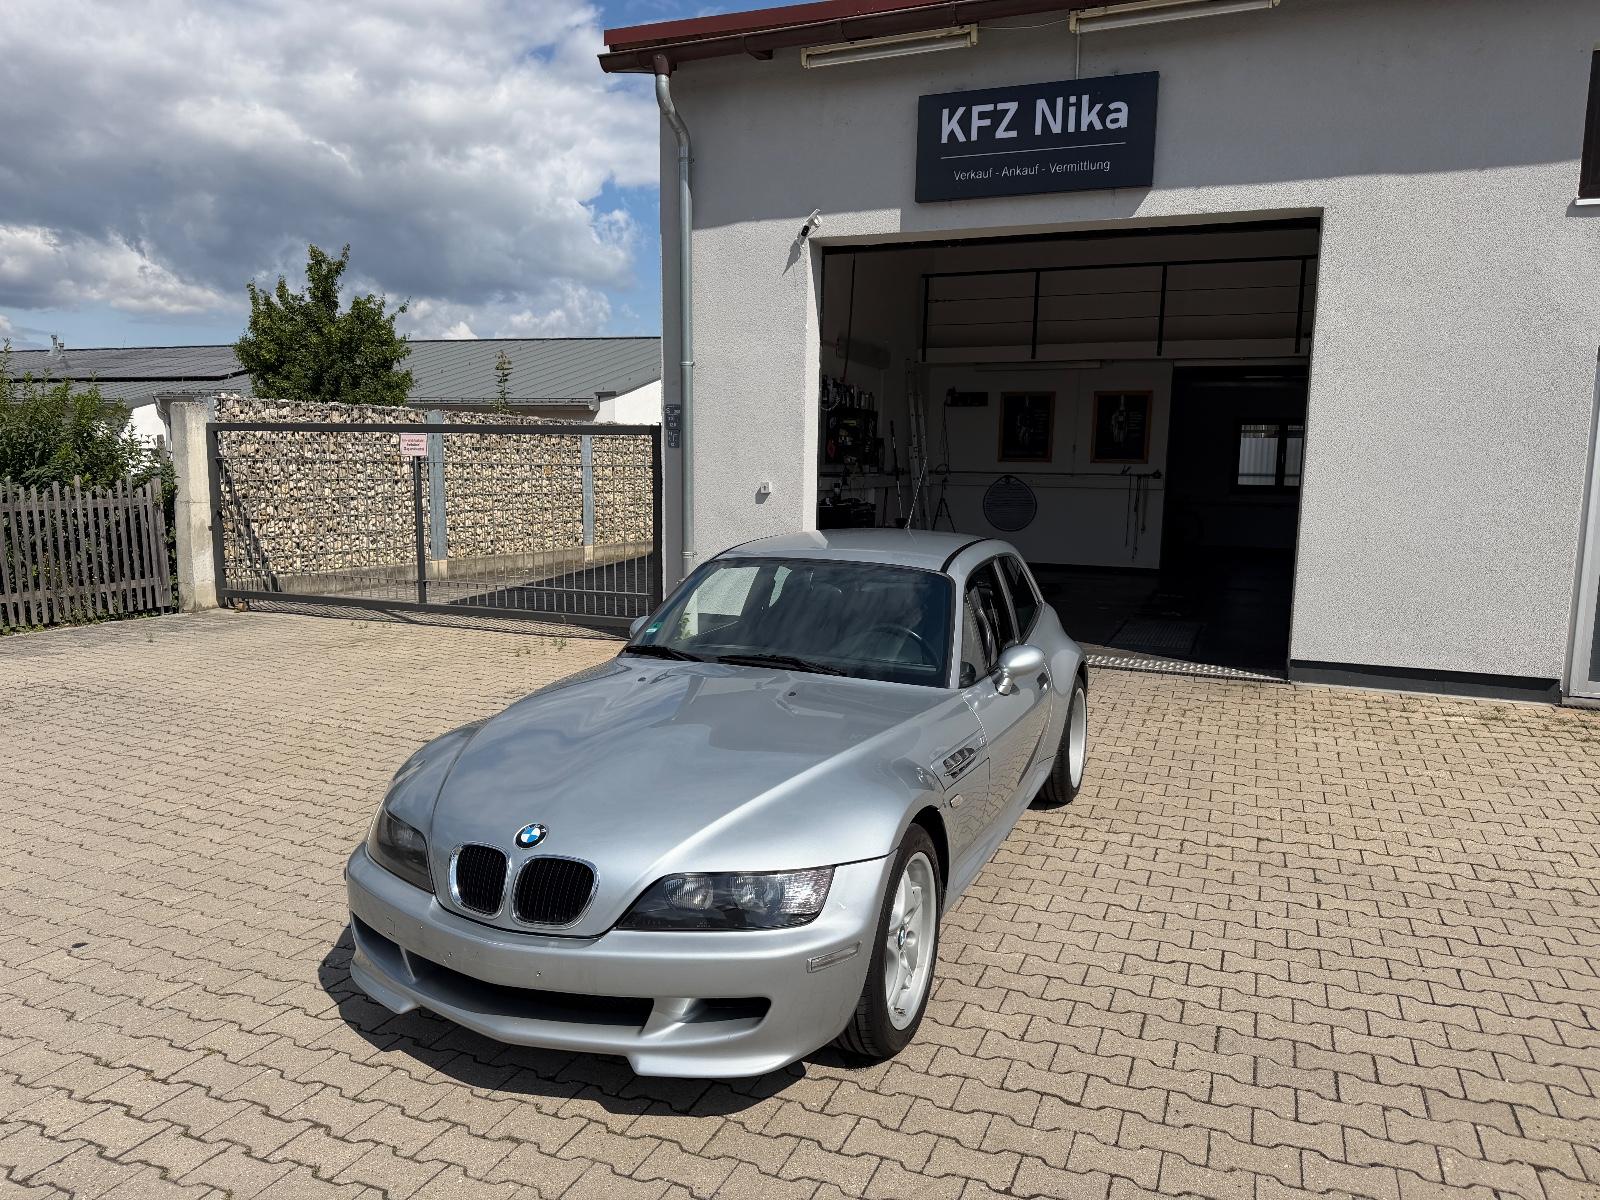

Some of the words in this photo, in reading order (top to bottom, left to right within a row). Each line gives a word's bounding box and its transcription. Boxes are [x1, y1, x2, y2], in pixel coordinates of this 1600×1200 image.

[940, 101, 1019, 144] KFZ
[1034, 94, 1129, 136] Nika
[953, 168, 993, 181] Verkauf
[1001, 163, 1039, 177] Ankauf
[1049, 160, 1111, 174] Vermittlung
